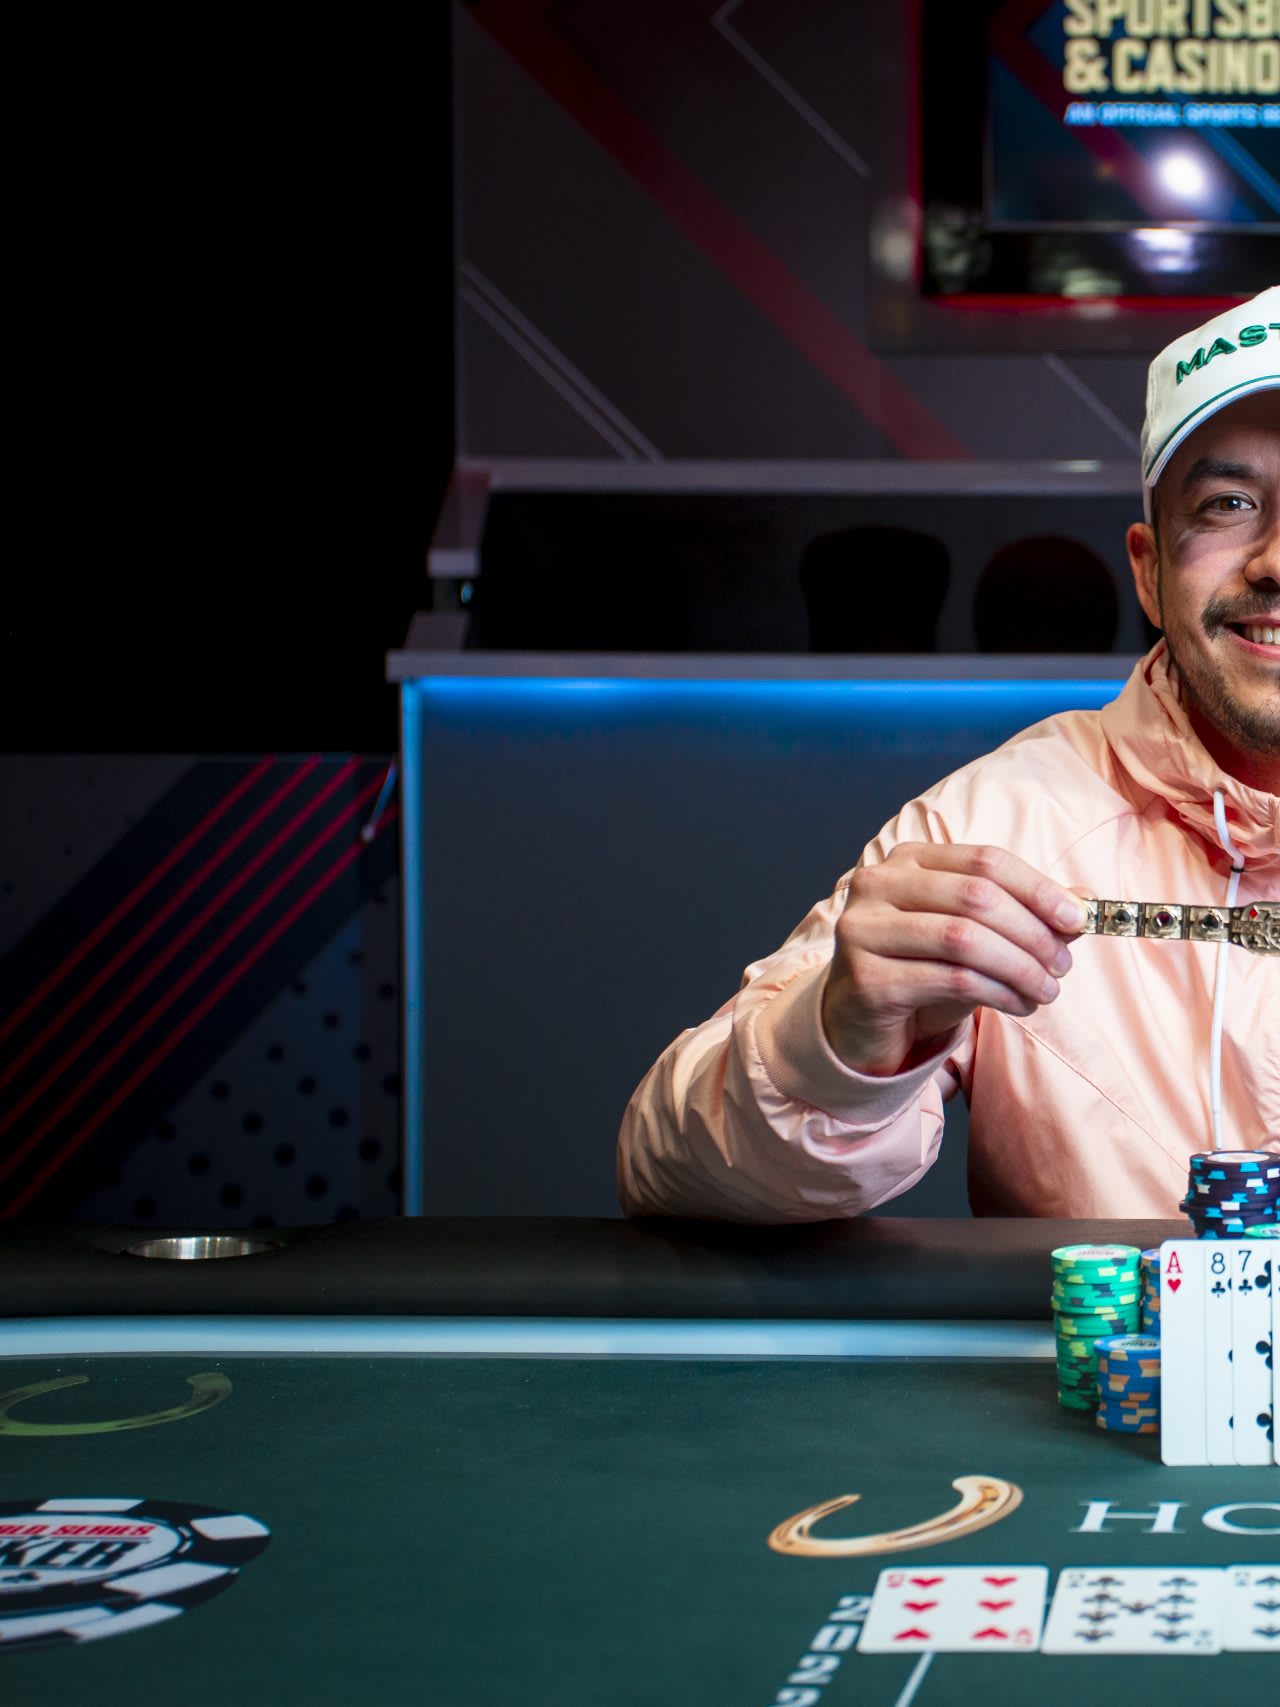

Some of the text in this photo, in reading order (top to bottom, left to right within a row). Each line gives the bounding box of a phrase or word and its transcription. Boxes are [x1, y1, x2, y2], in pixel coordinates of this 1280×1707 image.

[1063, 37, 1110, 93] &
[1166, 1251, 1183, 1274] A
[1211, 1252, 1226, 1274] 8
[1238, 1250, 1252, 1272] 7
